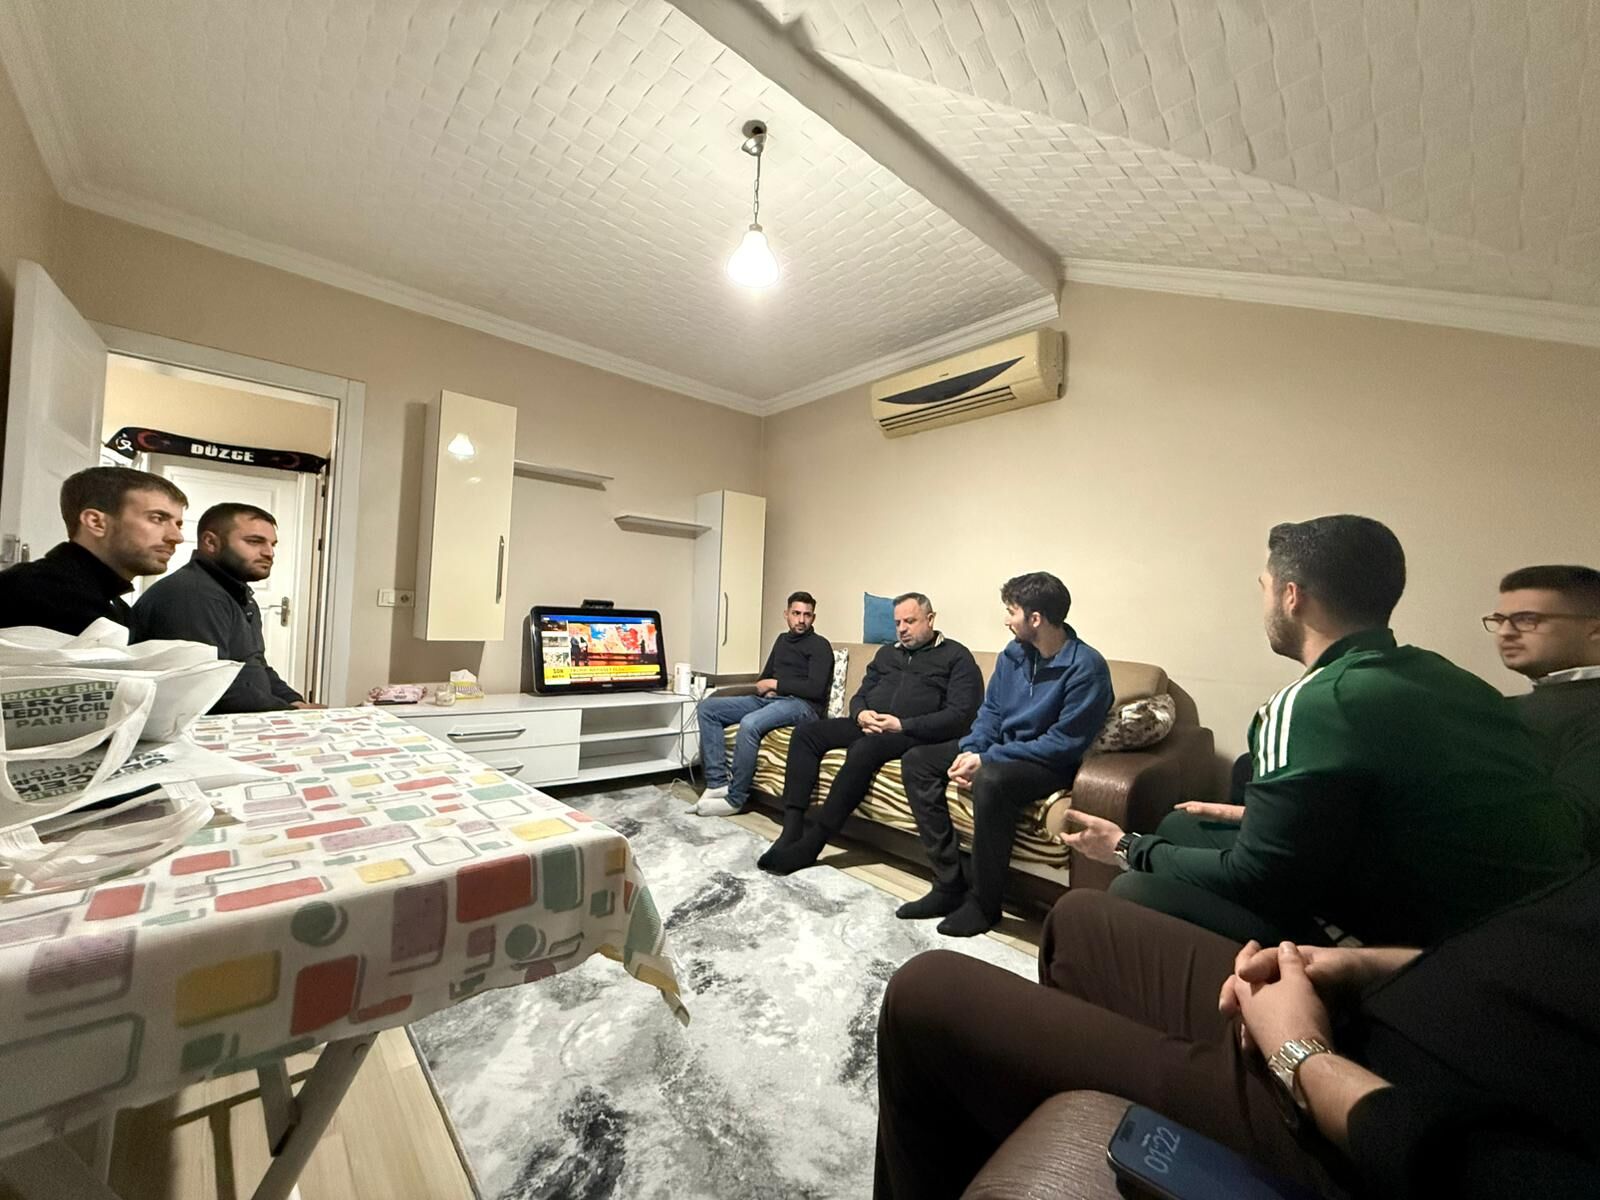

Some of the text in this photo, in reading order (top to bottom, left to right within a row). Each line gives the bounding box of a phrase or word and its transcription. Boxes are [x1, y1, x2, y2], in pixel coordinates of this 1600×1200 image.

[0, 686, 70, 701] RKİYE
[3, 702, 110, 720] LEDİYECİL
[16, 712, 109, 728] PARTİ'D
[1143, 1126, 1180, 1173] 01:22
